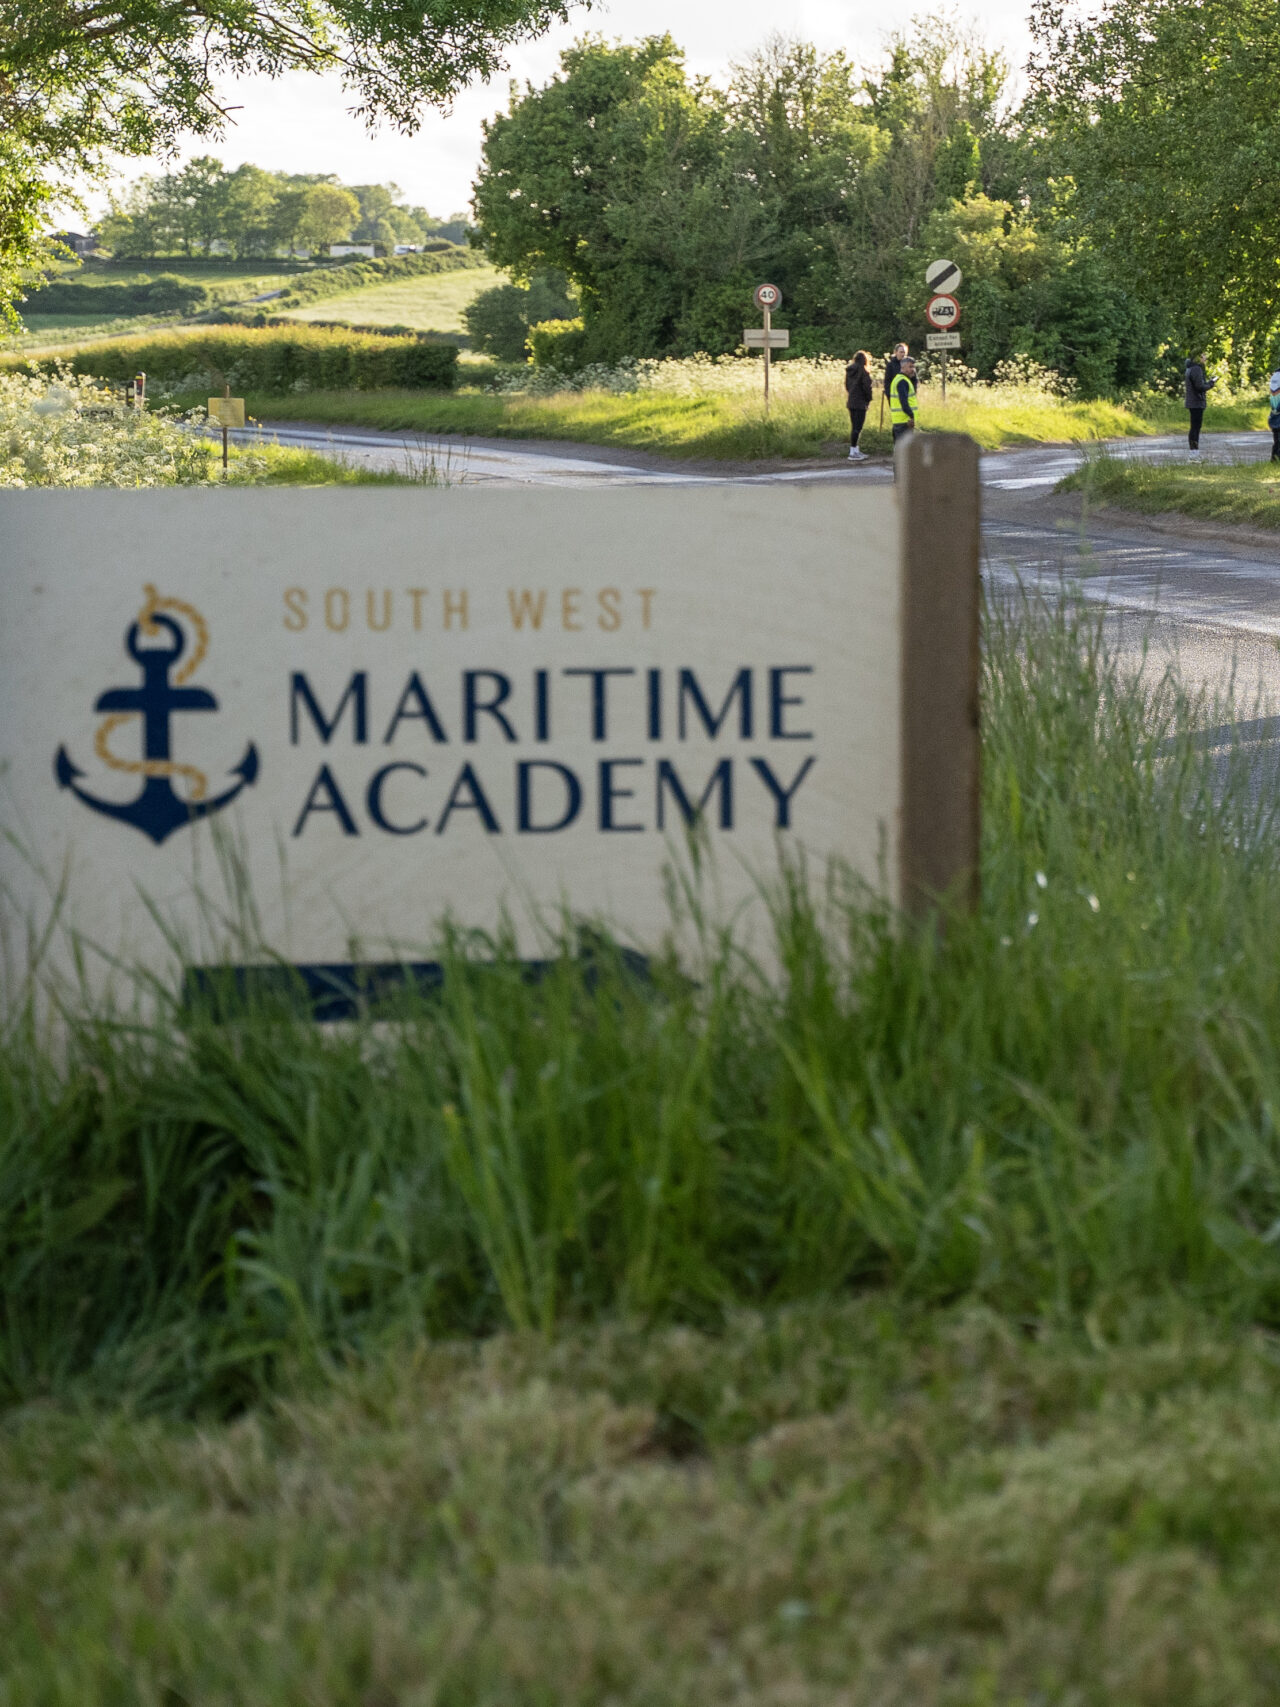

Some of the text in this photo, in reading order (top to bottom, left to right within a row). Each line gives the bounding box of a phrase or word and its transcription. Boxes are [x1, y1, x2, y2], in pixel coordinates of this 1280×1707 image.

[283, 587, 655, 632] SOUTH WEST
[290, 666, 814, 745] MARITIME
[291, 756, 815, 837] ACADEMY
